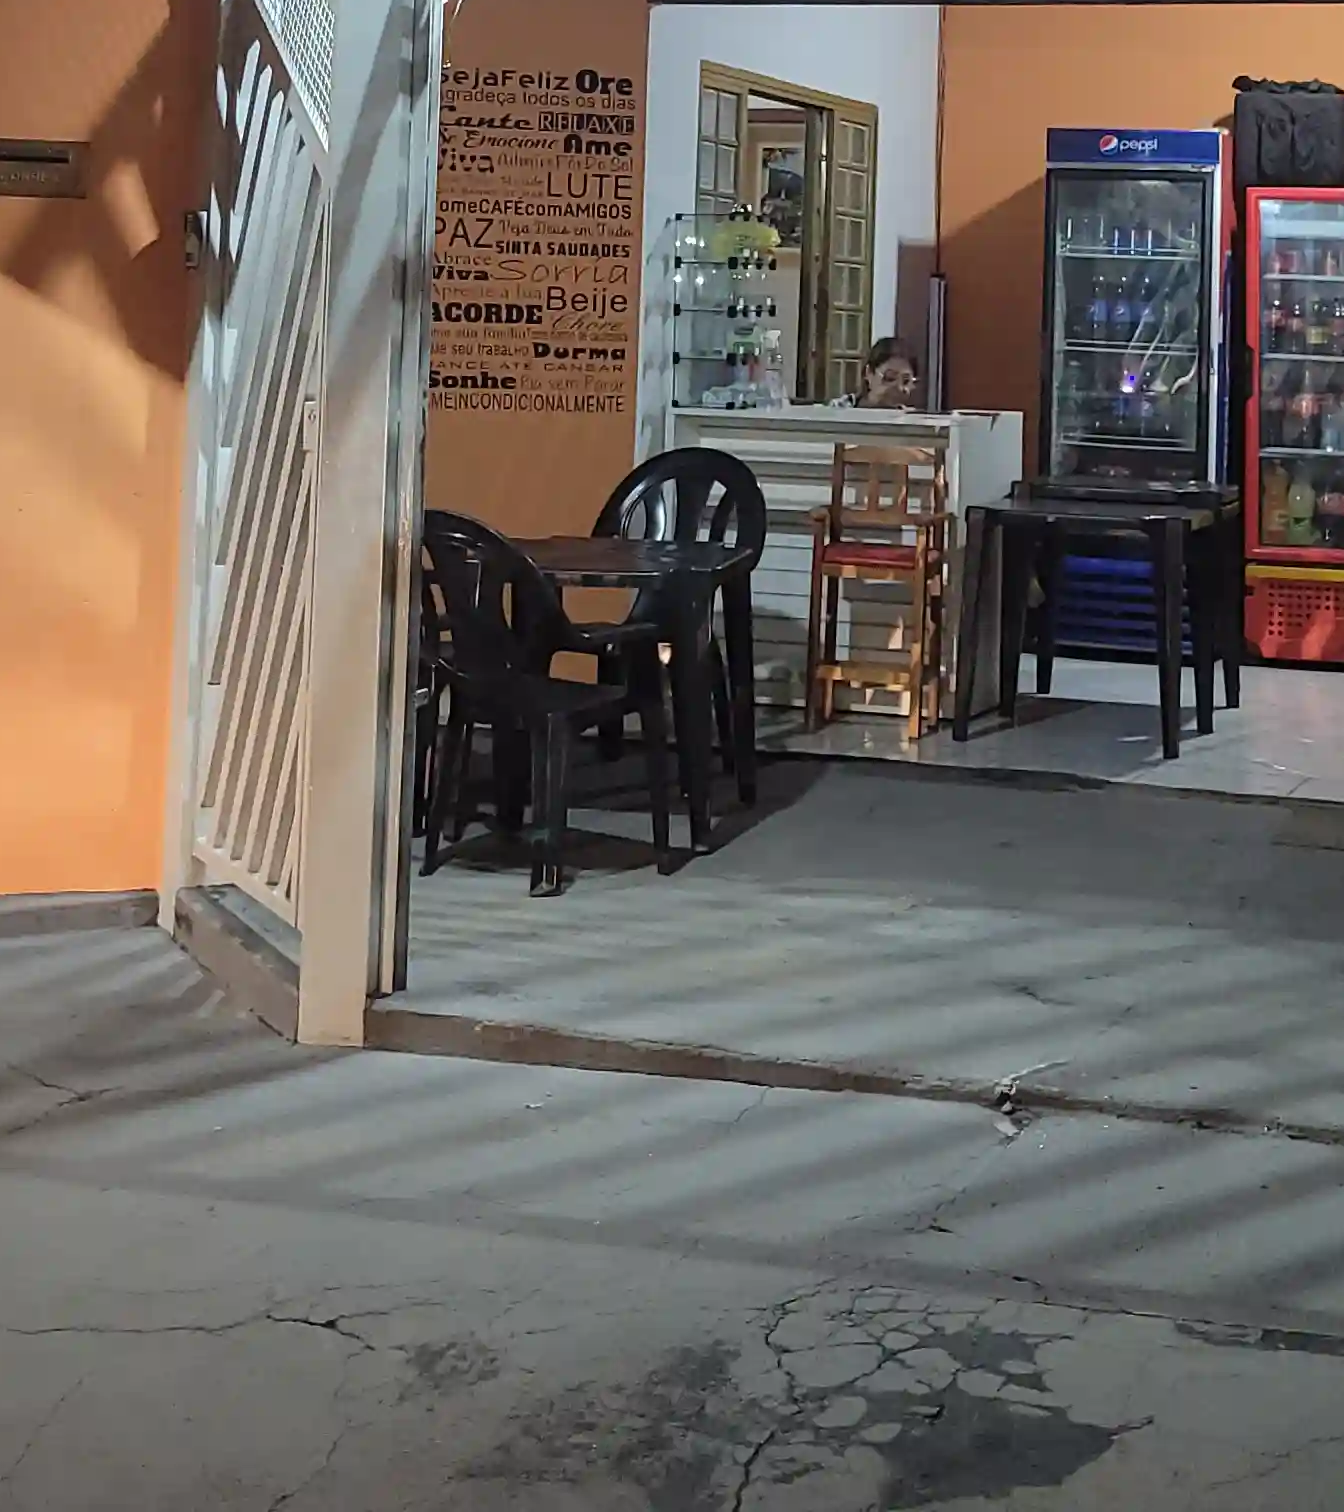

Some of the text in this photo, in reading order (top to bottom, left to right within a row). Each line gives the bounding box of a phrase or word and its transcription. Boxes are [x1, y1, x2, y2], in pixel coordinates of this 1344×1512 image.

[575, 68, 633, 95] Ore
[442, 88, 516, 106] gradeça
[538, 111, 635, 135] RELAXE
[564, 133, 632, 156] Ame
[1119, 136, 1158, 156] pepsi
[547, 171, 633, 201] LUTE
[495, 240, 631, 259] SINTA SAUDADES
[547, 286, 627, 318] Beije
[430, 360, 491, 371] ANCE
[429, 369, 517, 390] Sonhe
